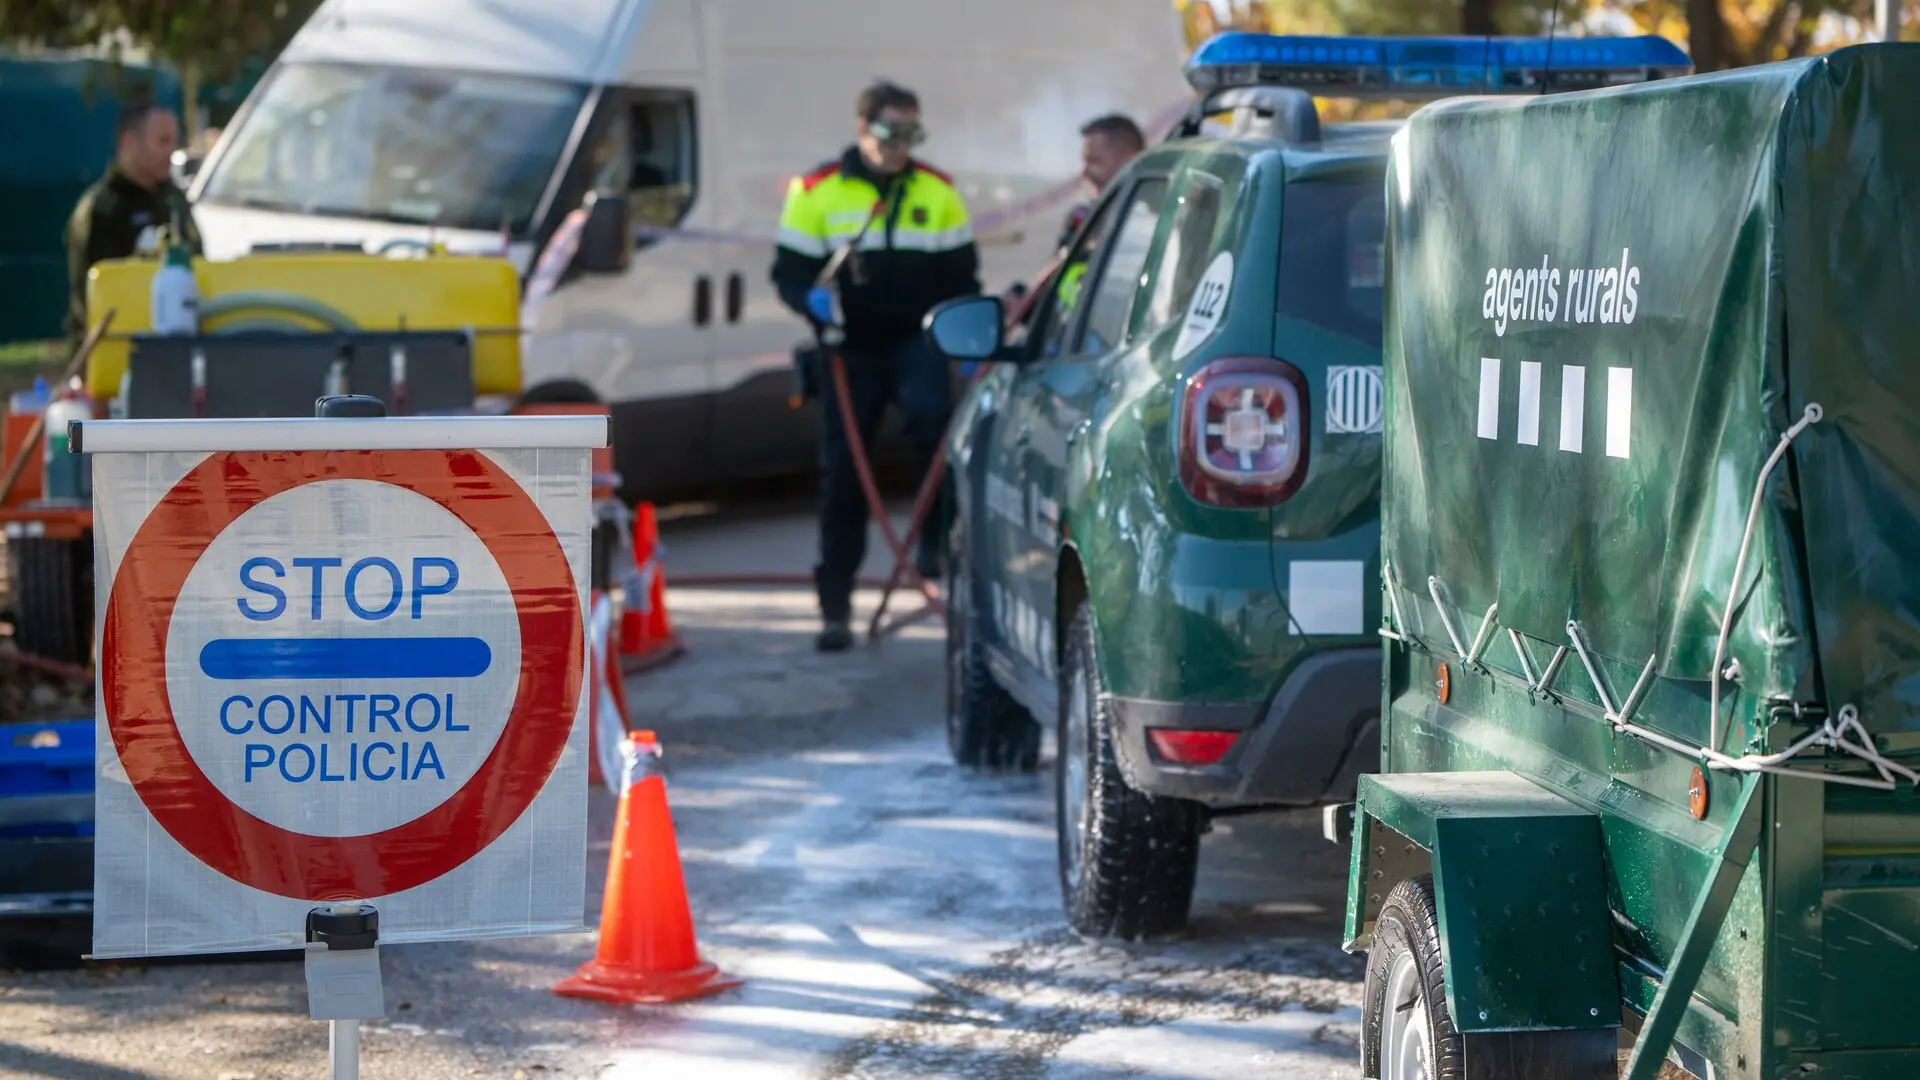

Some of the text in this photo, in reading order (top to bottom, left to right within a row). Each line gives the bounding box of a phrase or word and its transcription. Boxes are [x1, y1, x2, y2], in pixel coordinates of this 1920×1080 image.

[1193, 280, 1225, 319] 112
[1482, 247, 1641, 337] agents rurals
[236, 556, 459, 621] STOP
[218, 692, 471, 736] CONTROL
[243, 740, 446, 784] POLICIA
